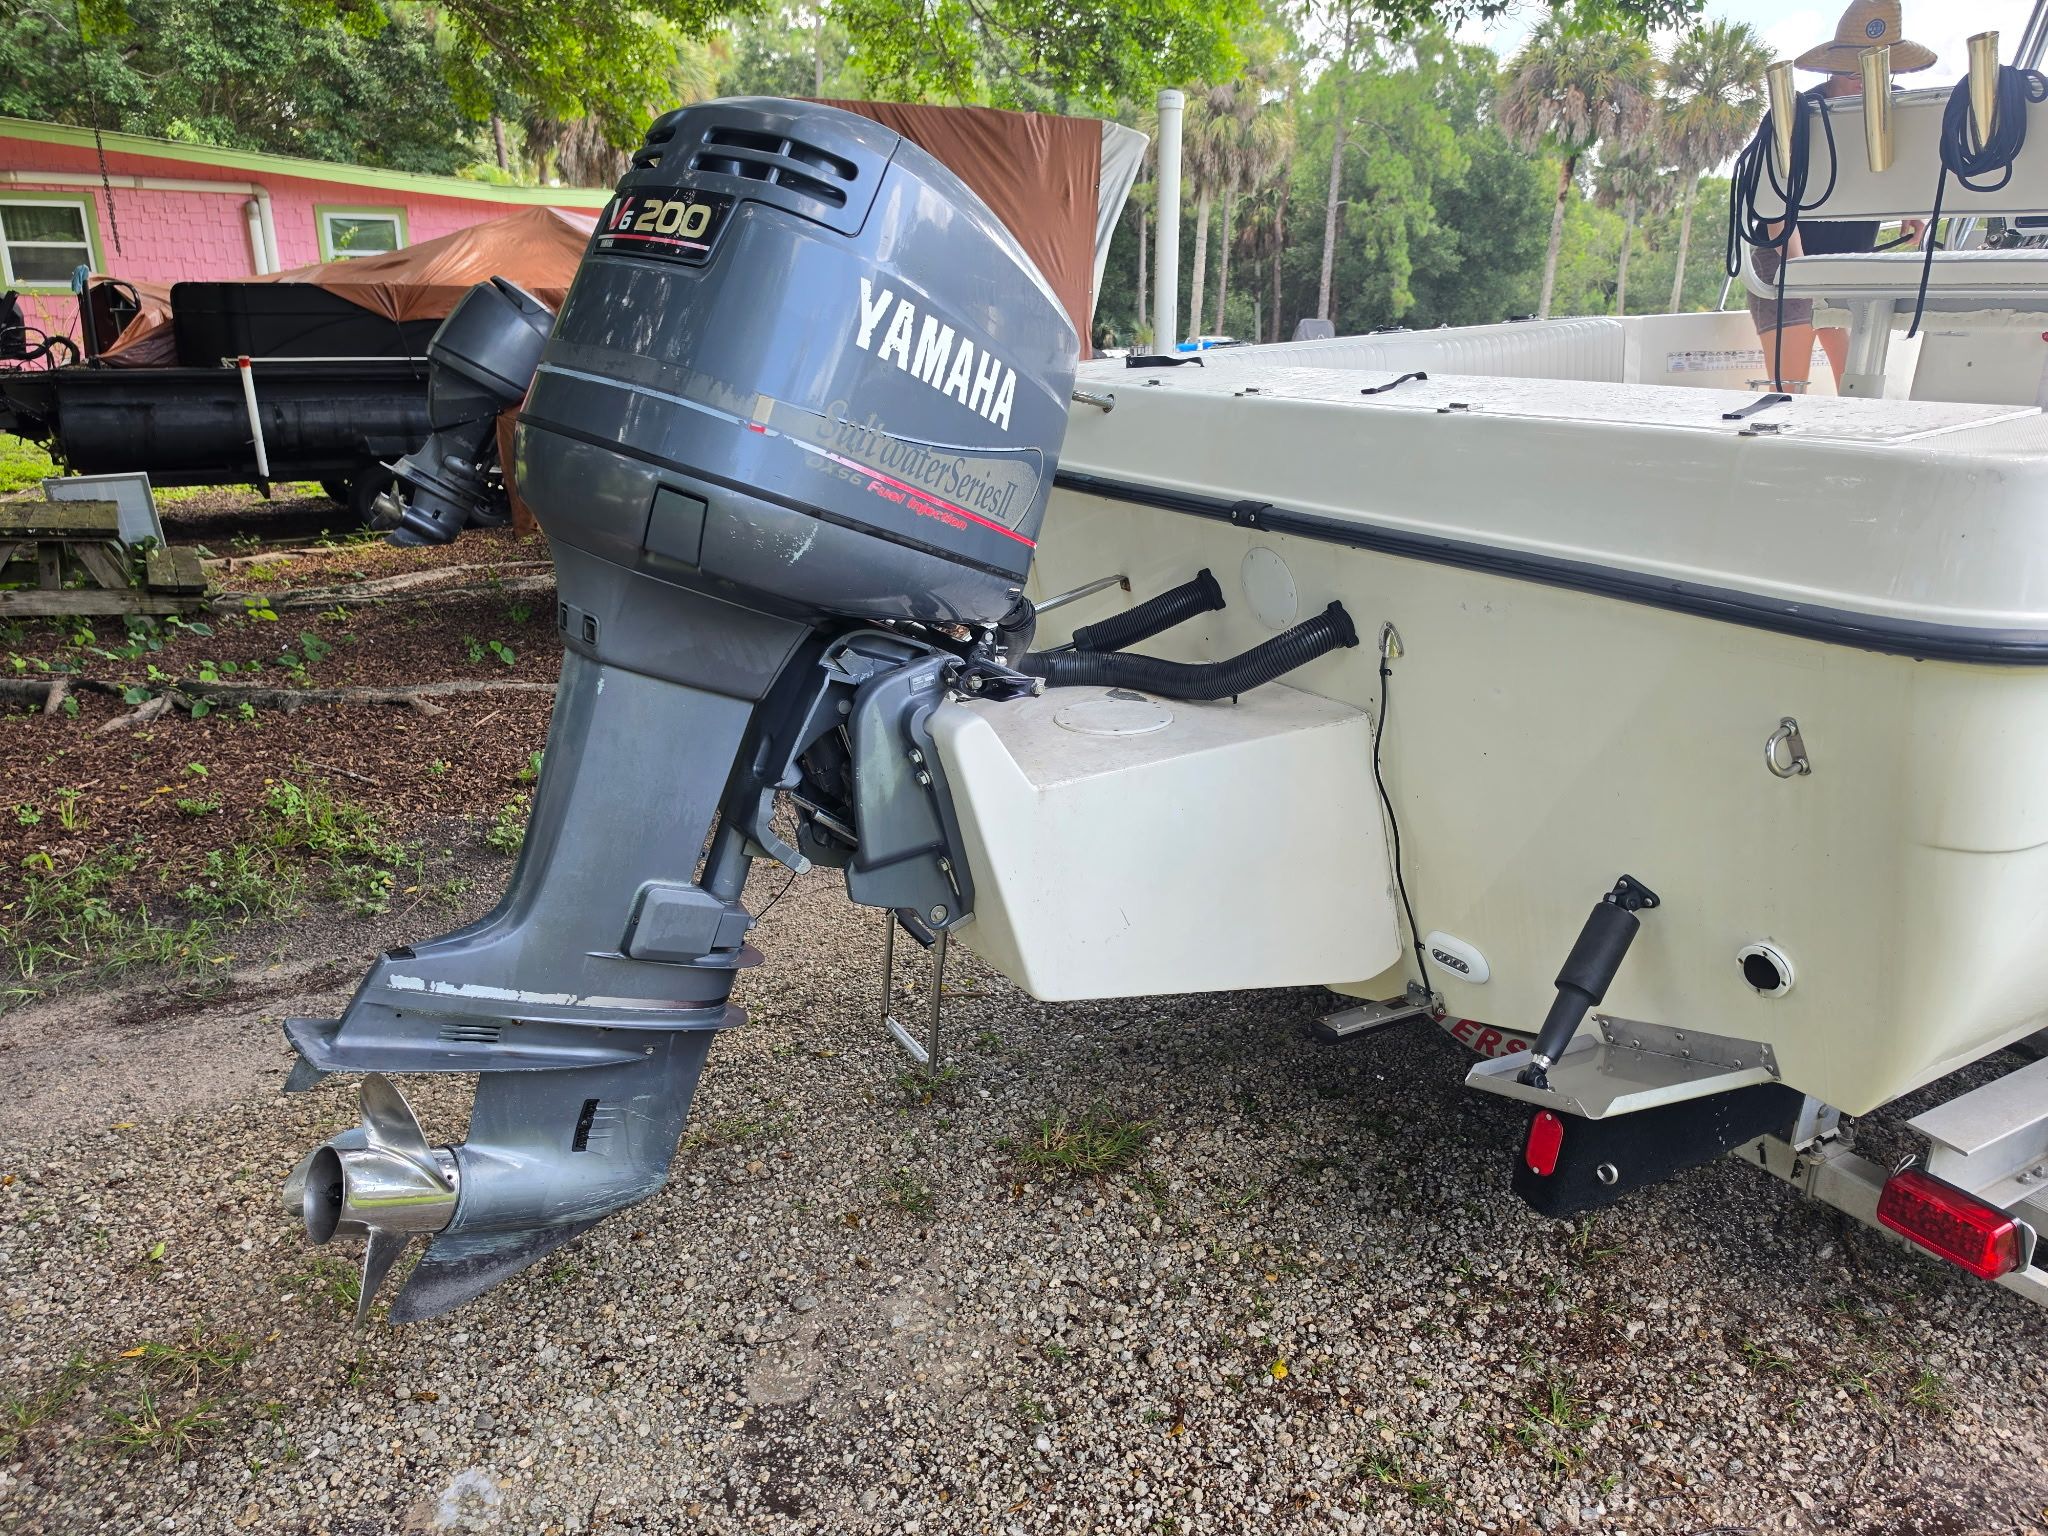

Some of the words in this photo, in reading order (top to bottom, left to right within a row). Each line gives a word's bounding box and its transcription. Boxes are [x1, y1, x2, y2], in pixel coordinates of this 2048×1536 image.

[608, 196, 635, 231] V6
[633, 199, 712, 239] 200
[855, 276, 1017, 432] YAMAHA
[866, 480, 905, 505] Fuel
[906, 497, 969, 532] Injection
